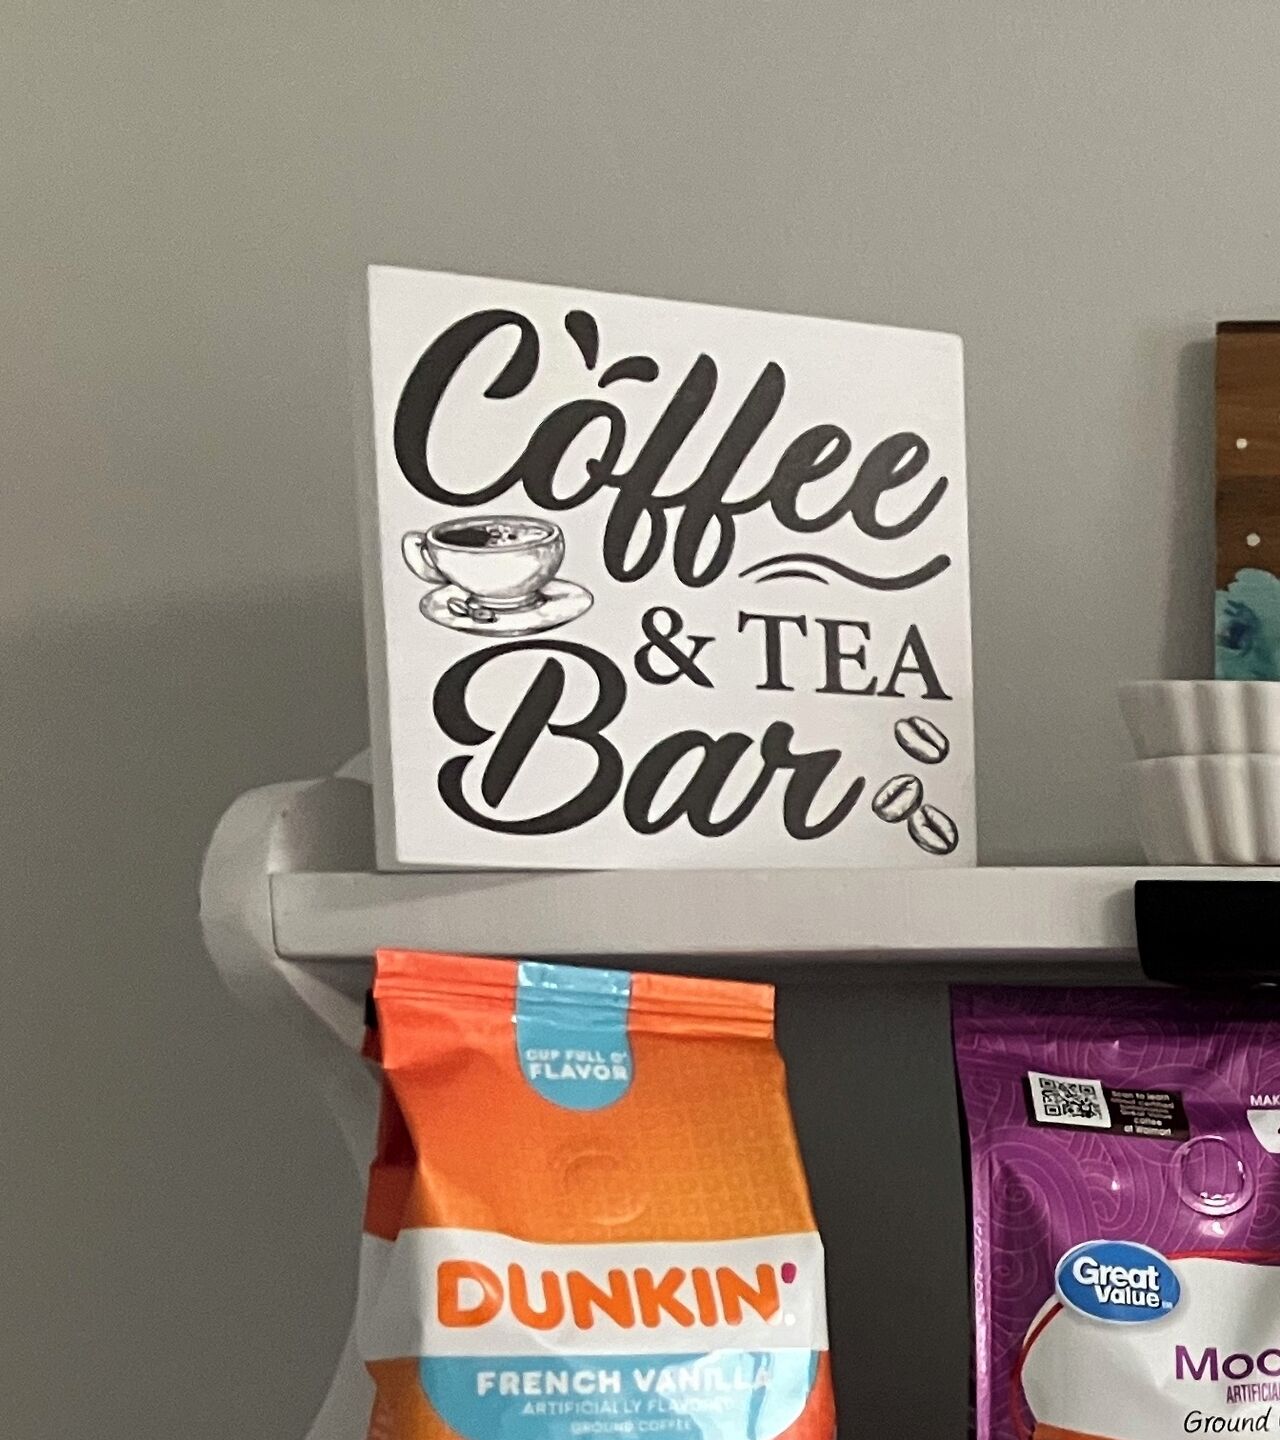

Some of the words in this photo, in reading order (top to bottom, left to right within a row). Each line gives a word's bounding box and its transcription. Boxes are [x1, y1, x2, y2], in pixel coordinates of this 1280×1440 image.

[394, 310, 950, 587] Coffee
[634, 607, 715, 688] &
[738, 611, 952, 700] TEA
[433, 640, 866, 840] Bar
[530, 1062, 629, 1080] FLAVOR
[1071, 1256, 1160, 1291] Great
[437, 1260, 797, 1330] DUNKIN'
[1095, 1285, 1160, 1308] Value
[476, 1369, 621, 1396] FRENCH
[1184, 1407, 1272, 1434] Ground
